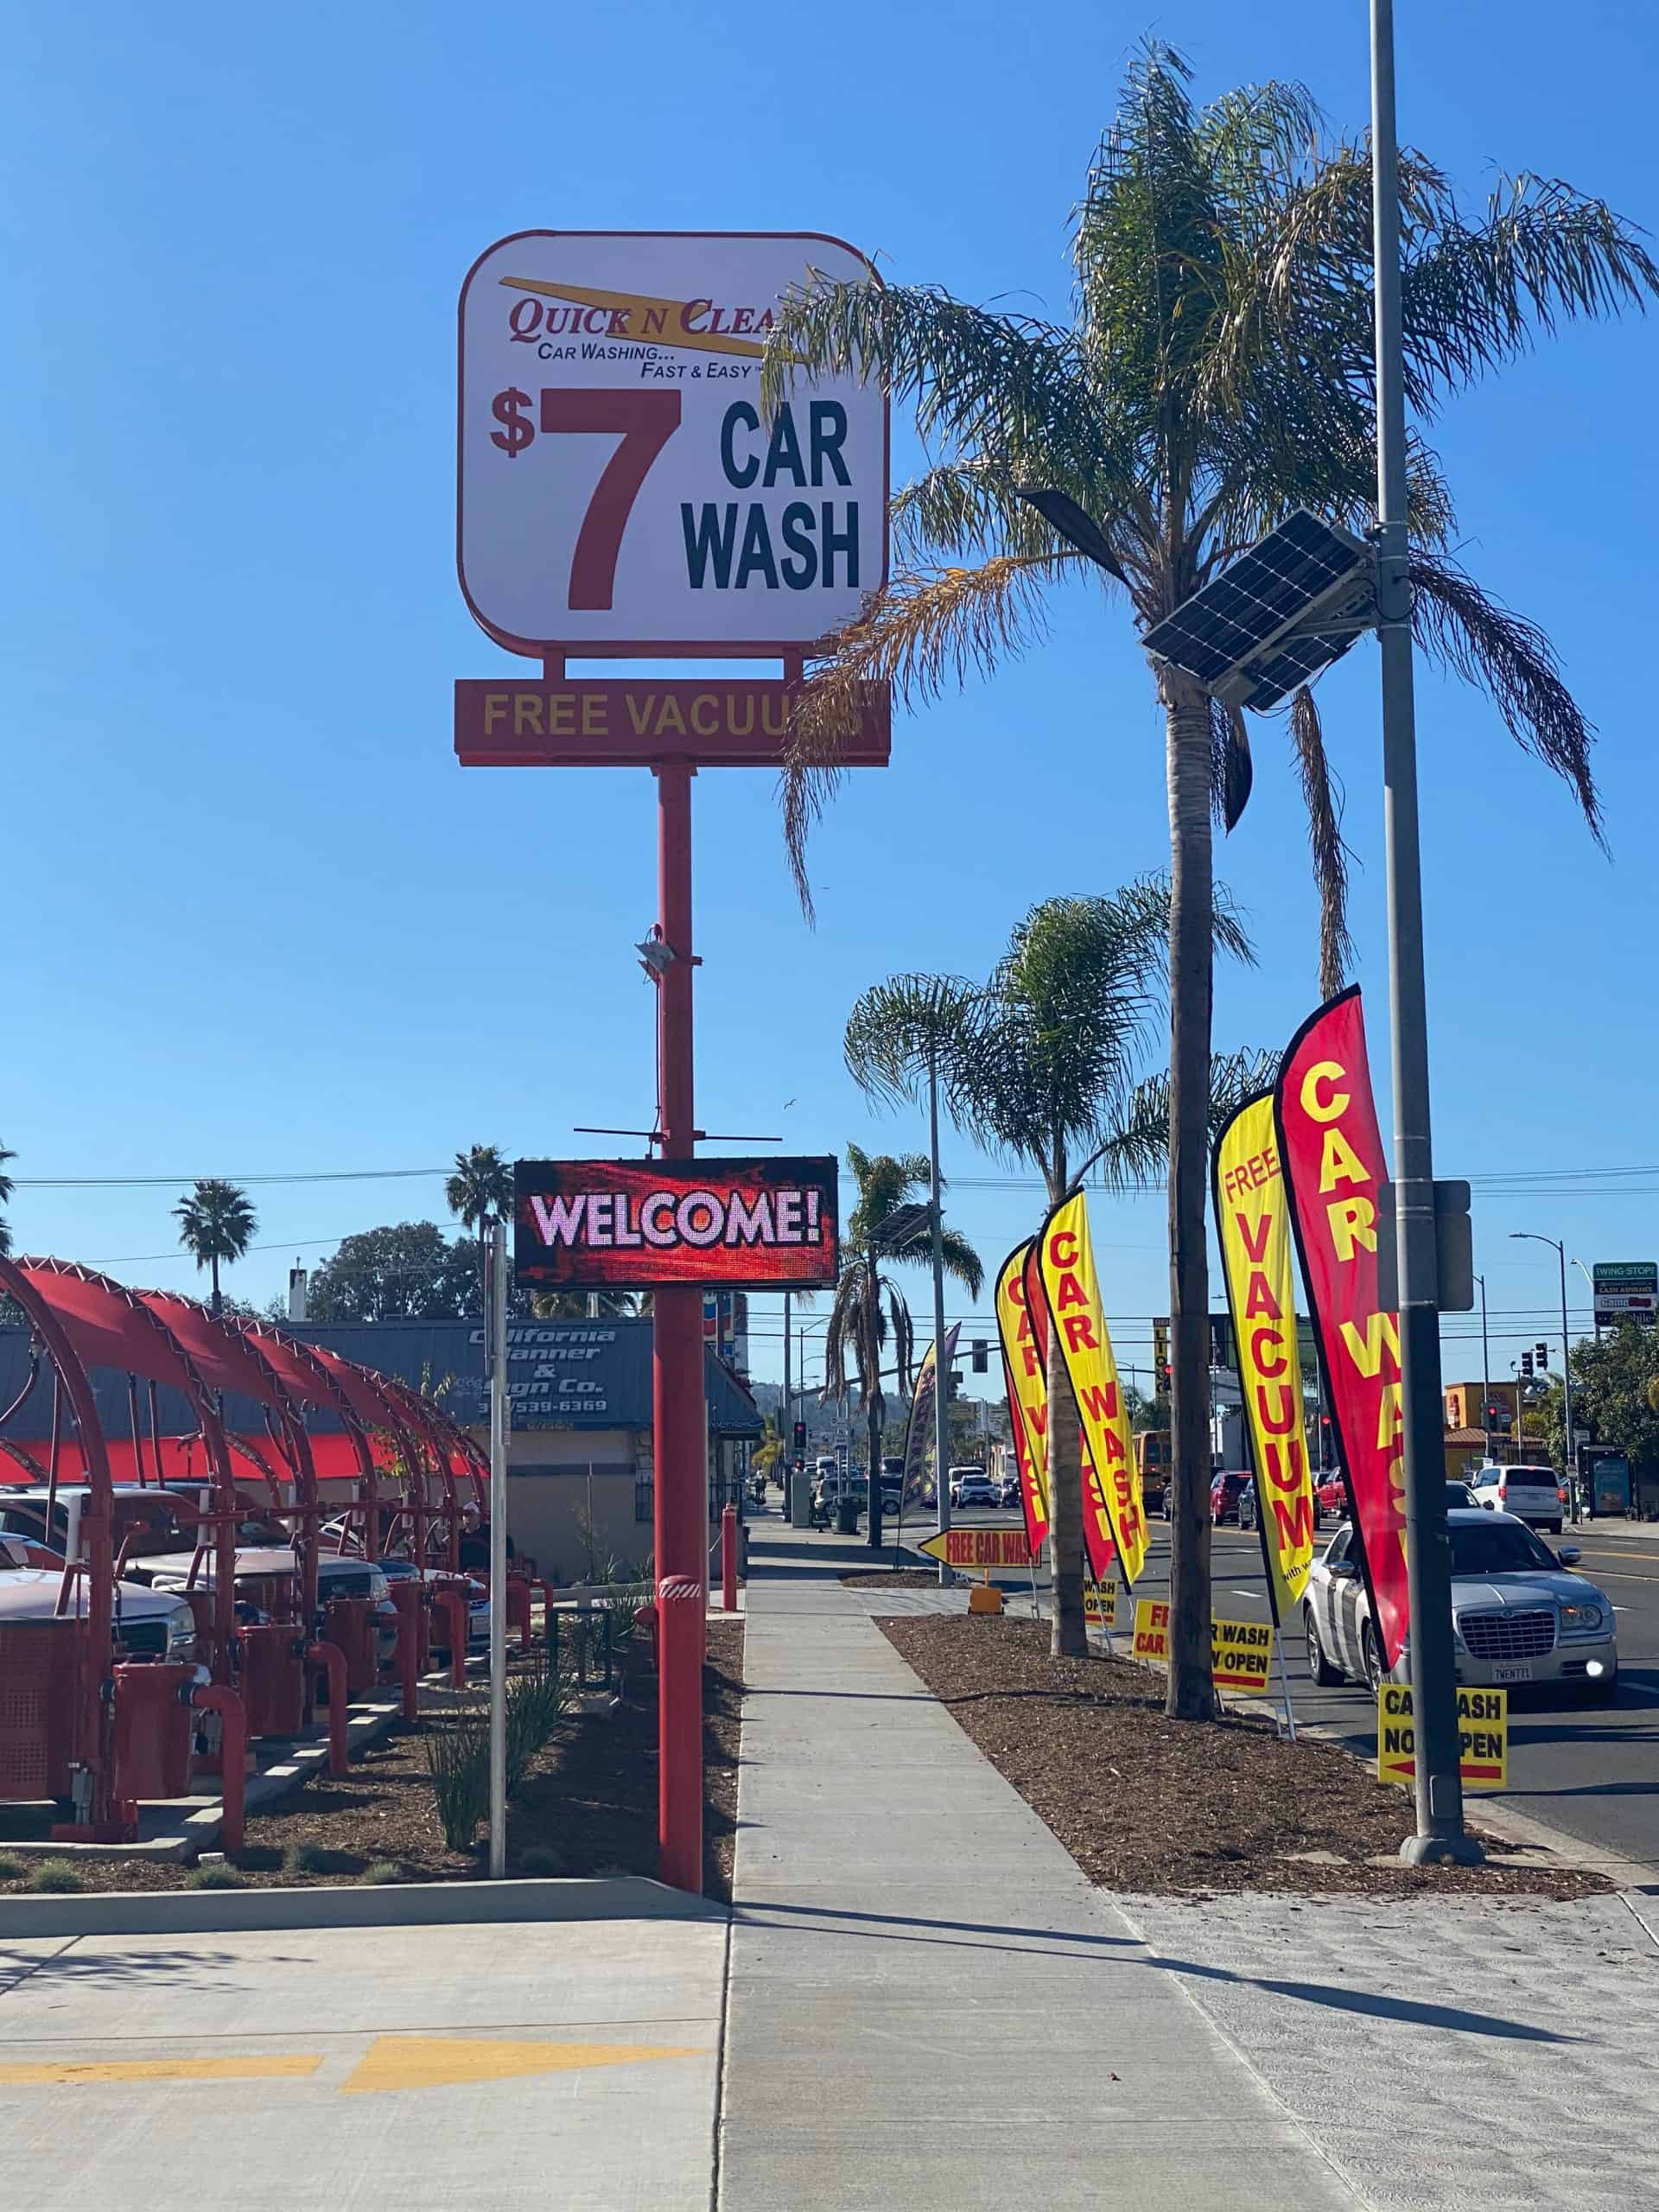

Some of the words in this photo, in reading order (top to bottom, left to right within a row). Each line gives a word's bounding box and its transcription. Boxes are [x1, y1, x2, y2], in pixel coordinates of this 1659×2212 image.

[642, 308, 669, 334] N
[680, 299, 790, 334] CLEA
[691, 366, 702, 378] &
[720, 400, 852, 488] CAR
[680, 501, 859, 590] WASH
[484, 694, 609, 735] FREE
[625, 694, 857, 736] VACUU
[1224, 1147, 1282, 1204] FREE
[1300, 1061, 1376, 1262] CAR
[530, 1190, 820, 1246] WELCOME!
[1050, 1231, 1099, 1354] CAR
[469, 1328, 616, 1344] Clifornia
[506, 1348, 601, 1360] anner
[534, 1363, 556, 1378] &
[558, 1379, 604, 1393] Co.
[477, 1401, 607, 1413] 3/539-6369
[1080, 1381, 1141, 1549] WASH
[946, 1533, 974, 1563] FREE
[976, 1533, 1000, 1563] CAR
[1136, 1632, 1165, 1654] CAR
[1223, 1624, 1268, 1646] WASH
[1224, 1653, 1268, 1674] OPEN
[1385, 1690, 1414, 1715] CA
[1458, 1694, 1501, 1719] ASH
[1384, 1728, 1414, 1753] NO
[1459, 1732, 1503, 1758] PEN
